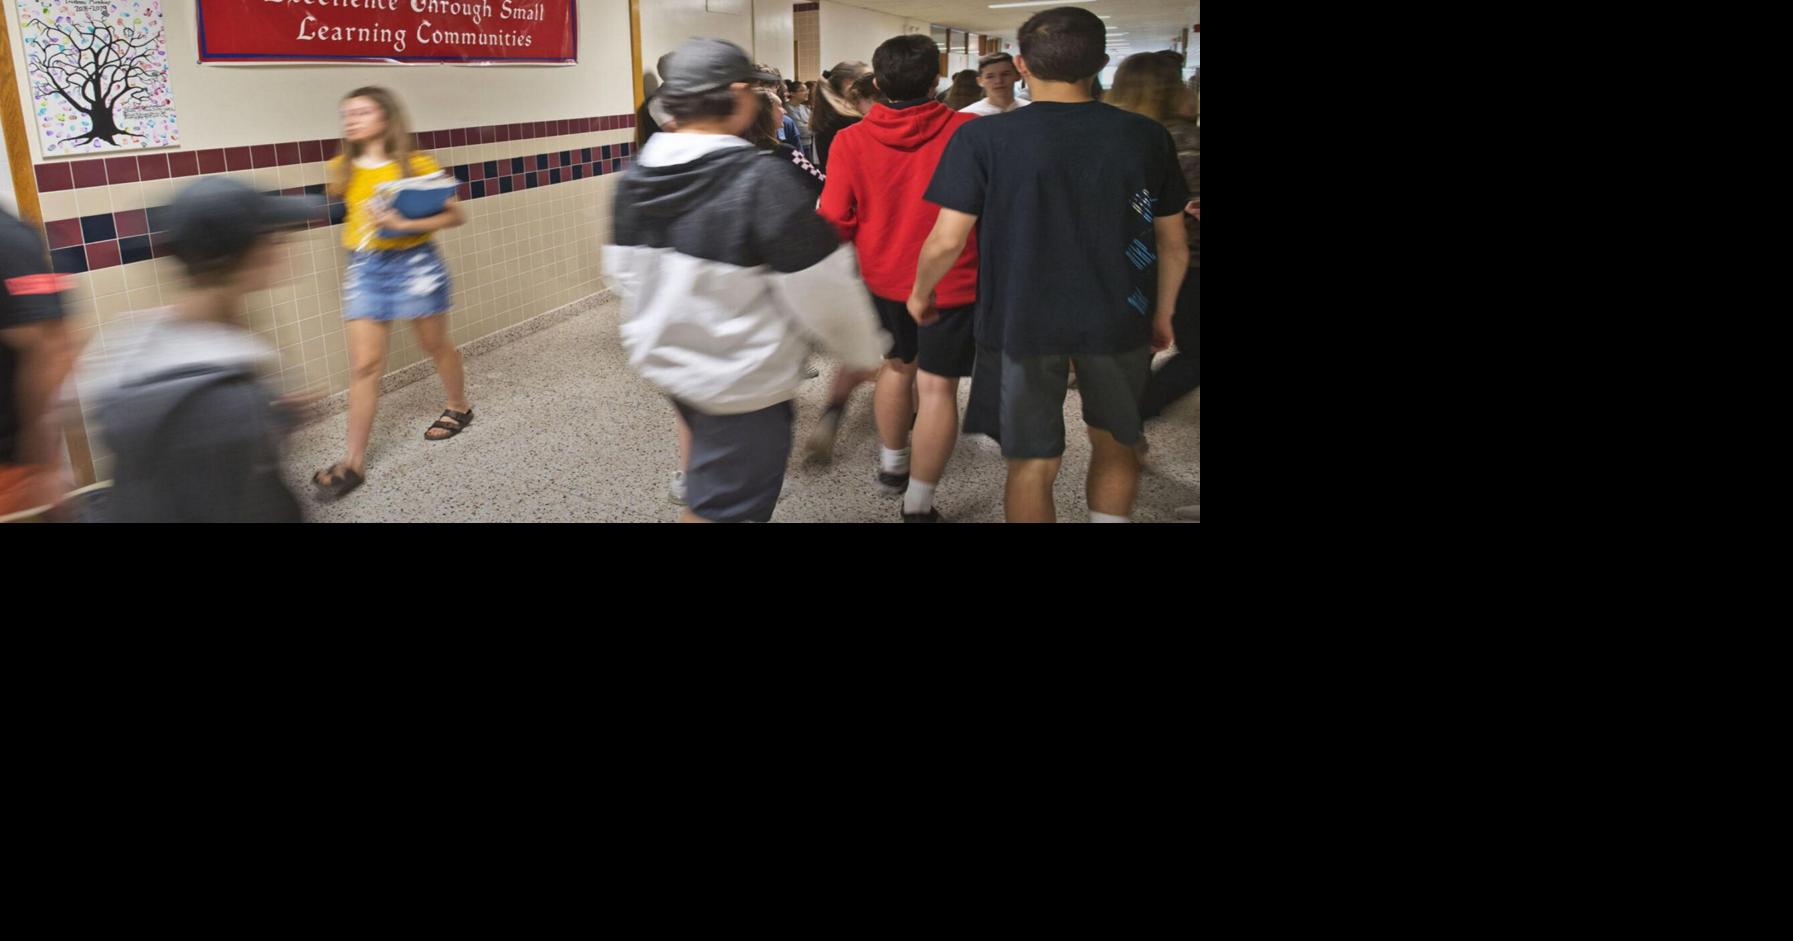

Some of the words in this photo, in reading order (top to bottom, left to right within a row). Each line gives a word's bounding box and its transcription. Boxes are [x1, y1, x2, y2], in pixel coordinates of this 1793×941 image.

[264, 0, 399, 11] ceence
[410, 0, 492, 25] Through
[500, 0, 544, 21] Small
[296, 14, 407, 52] Learning
[416, 19, 533, 47] Communities
